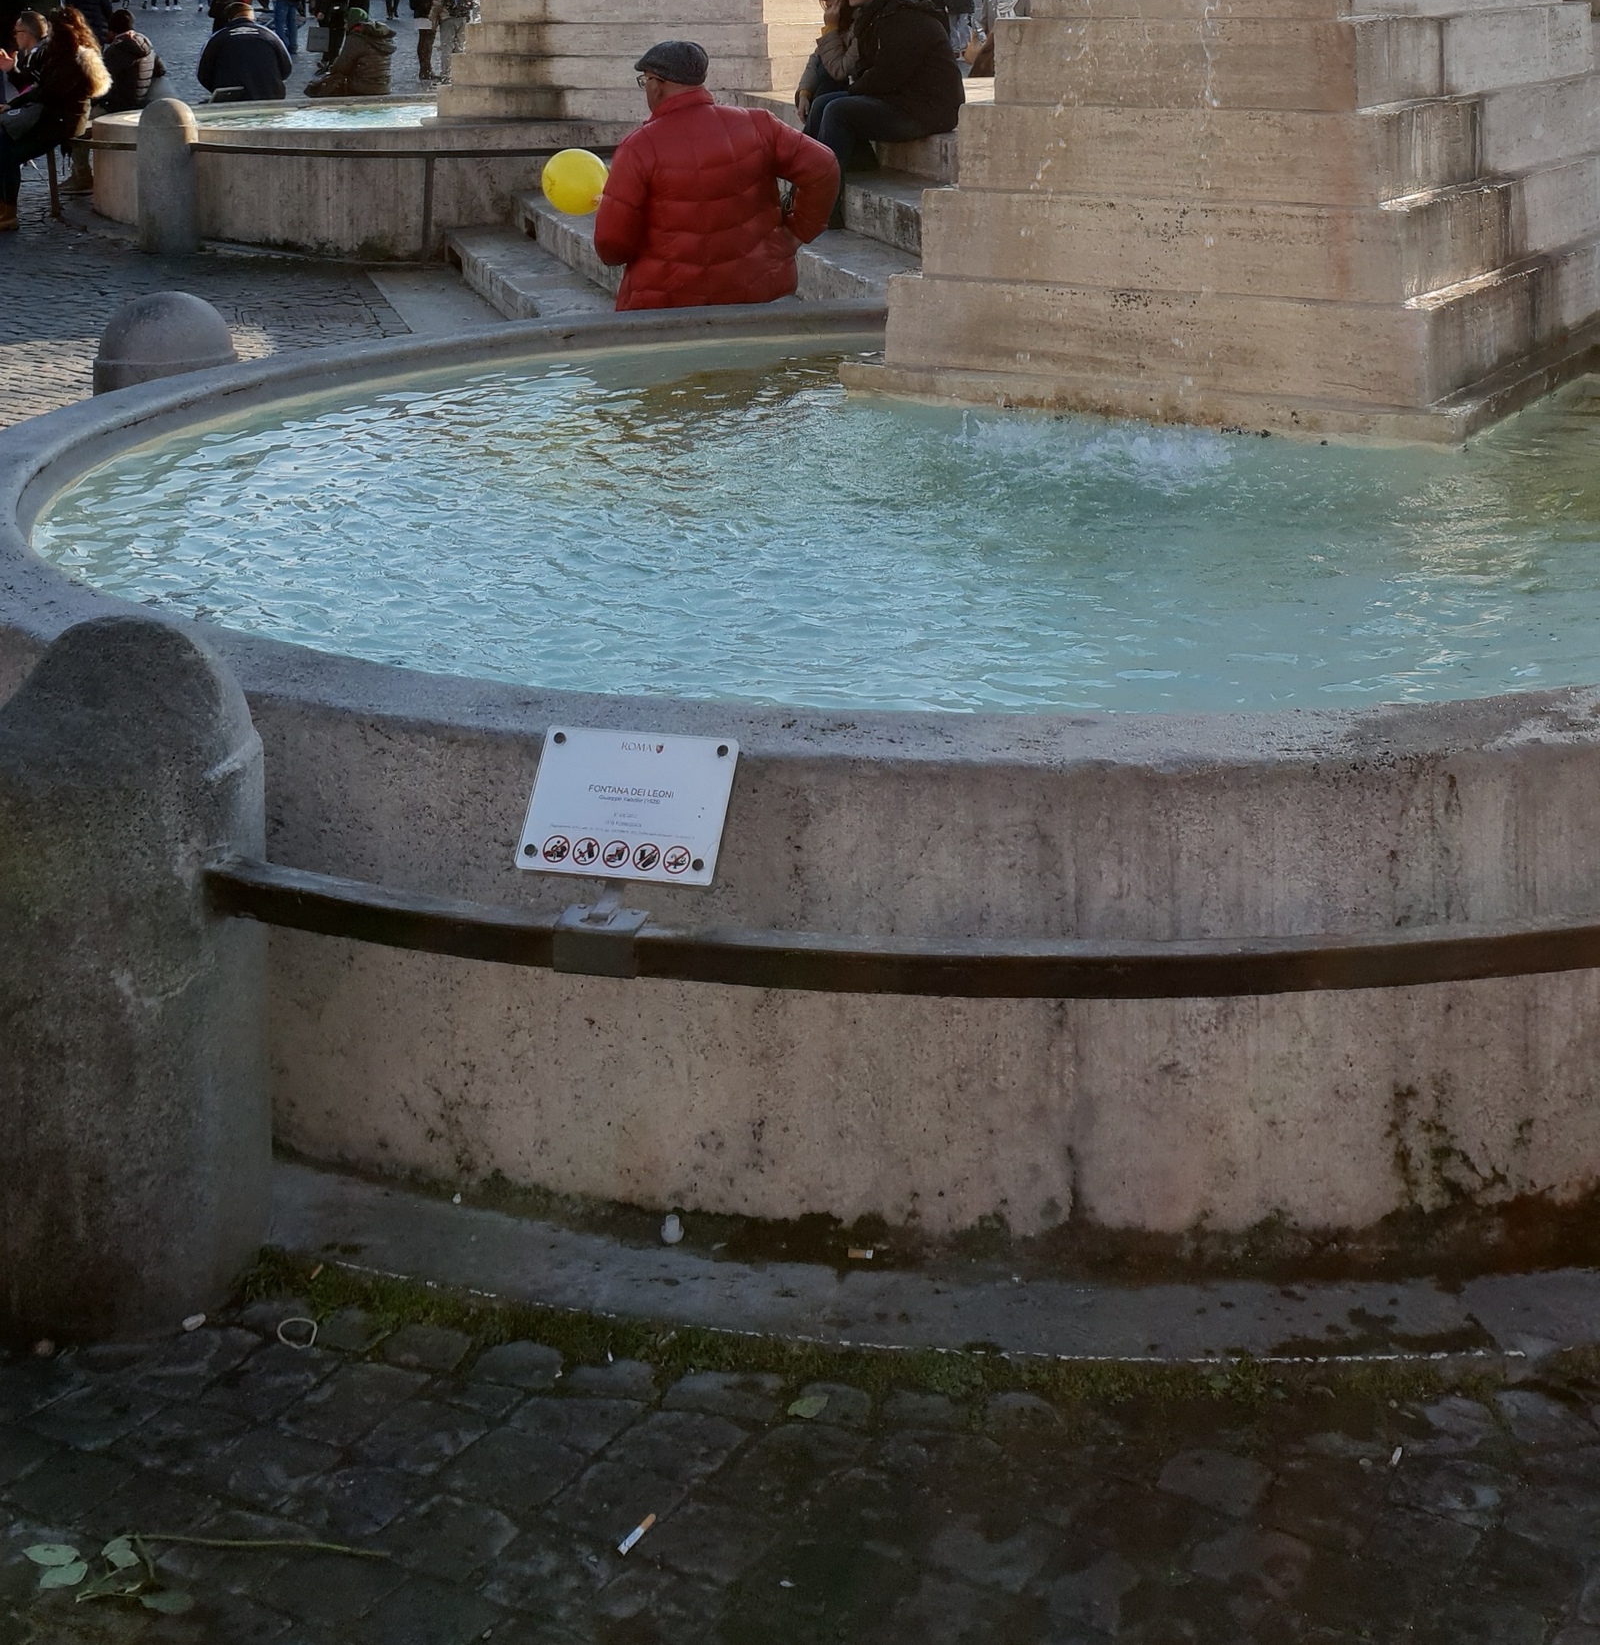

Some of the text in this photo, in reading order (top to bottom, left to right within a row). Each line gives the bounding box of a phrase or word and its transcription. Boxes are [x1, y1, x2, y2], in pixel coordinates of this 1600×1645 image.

[621, 741, 653, 752] ROMA
[588, 784, 675, 799] FONTANA DEI LEONI
